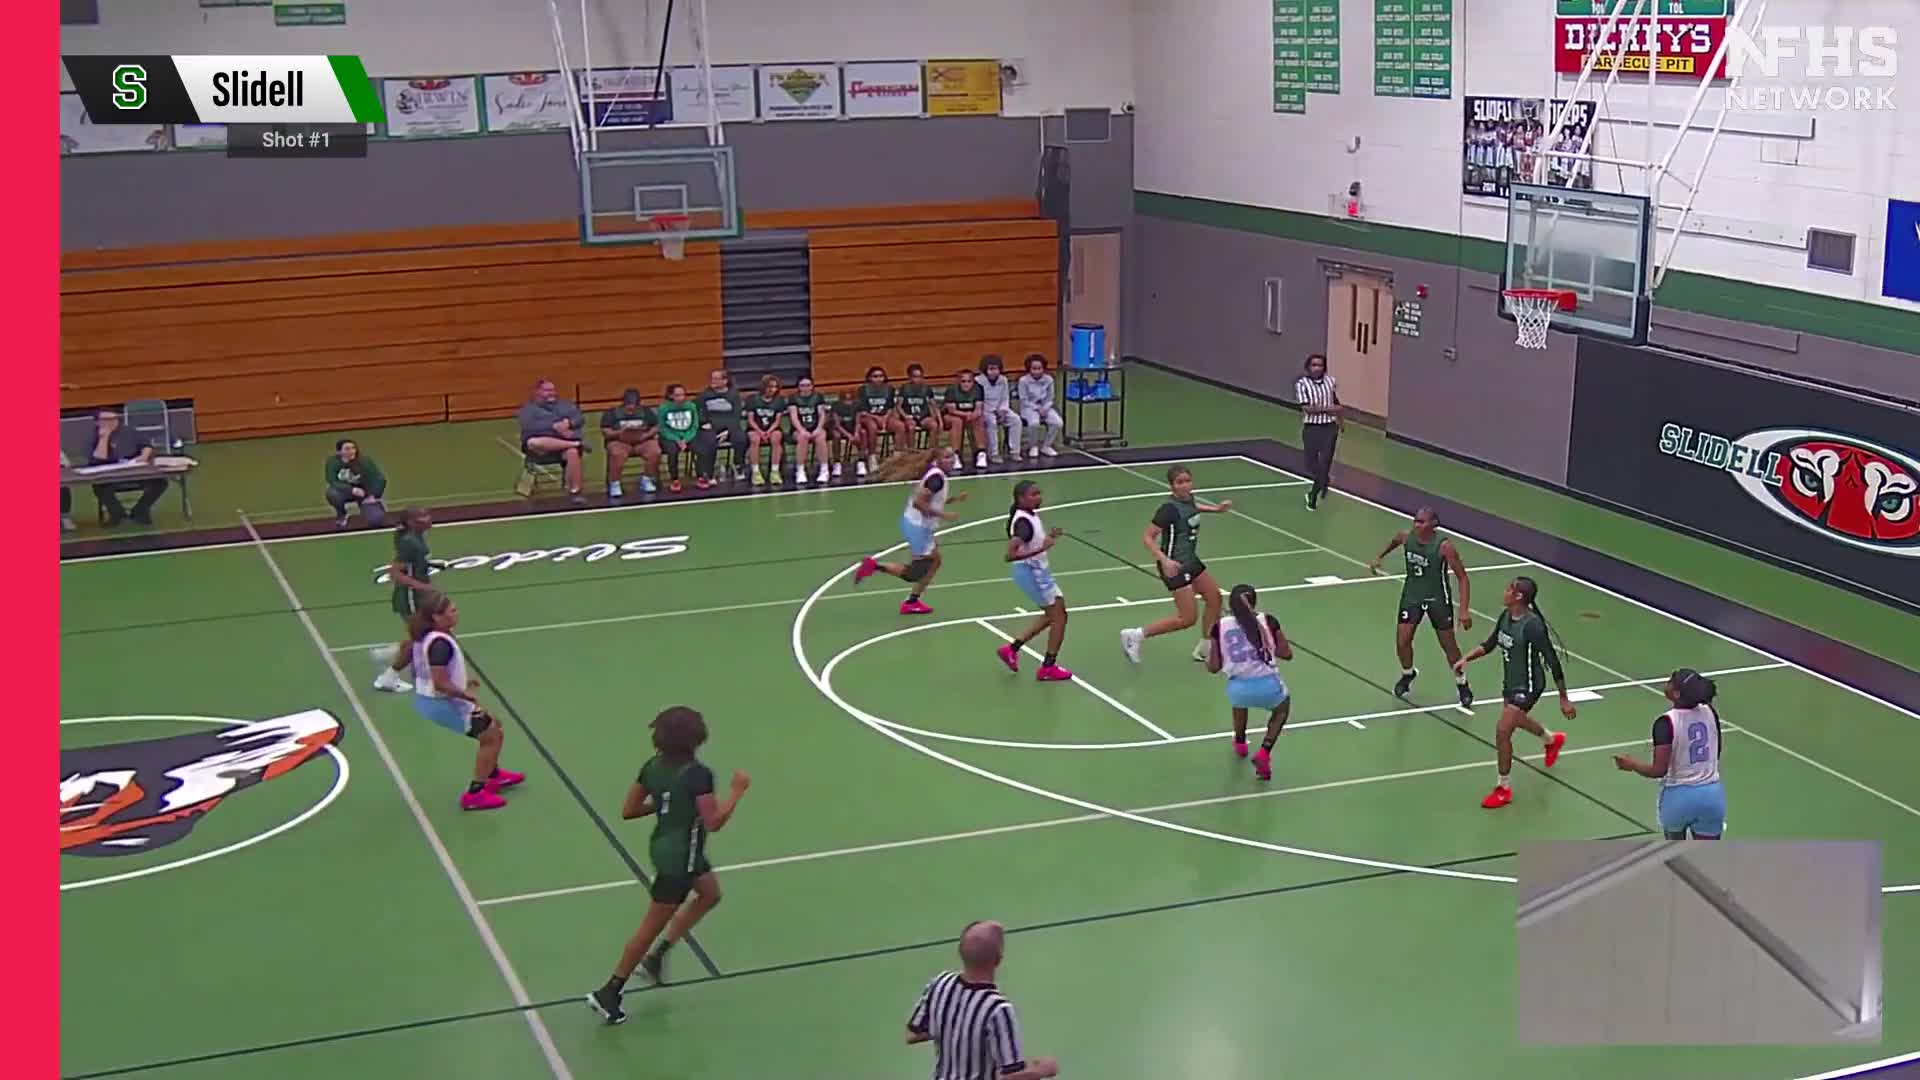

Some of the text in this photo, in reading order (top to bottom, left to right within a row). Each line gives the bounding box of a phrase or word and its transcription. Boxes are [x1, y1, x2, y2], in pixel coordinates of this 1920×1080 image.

[1583, 56, 1690, 71] ARECUE PIT
[1659, 422, 1784, 487] SLIDELL
[374, 535, 690, 584] Slide
[1414, 565, 1424, 577] 3
[1688, 721, 1710, 765] 2
